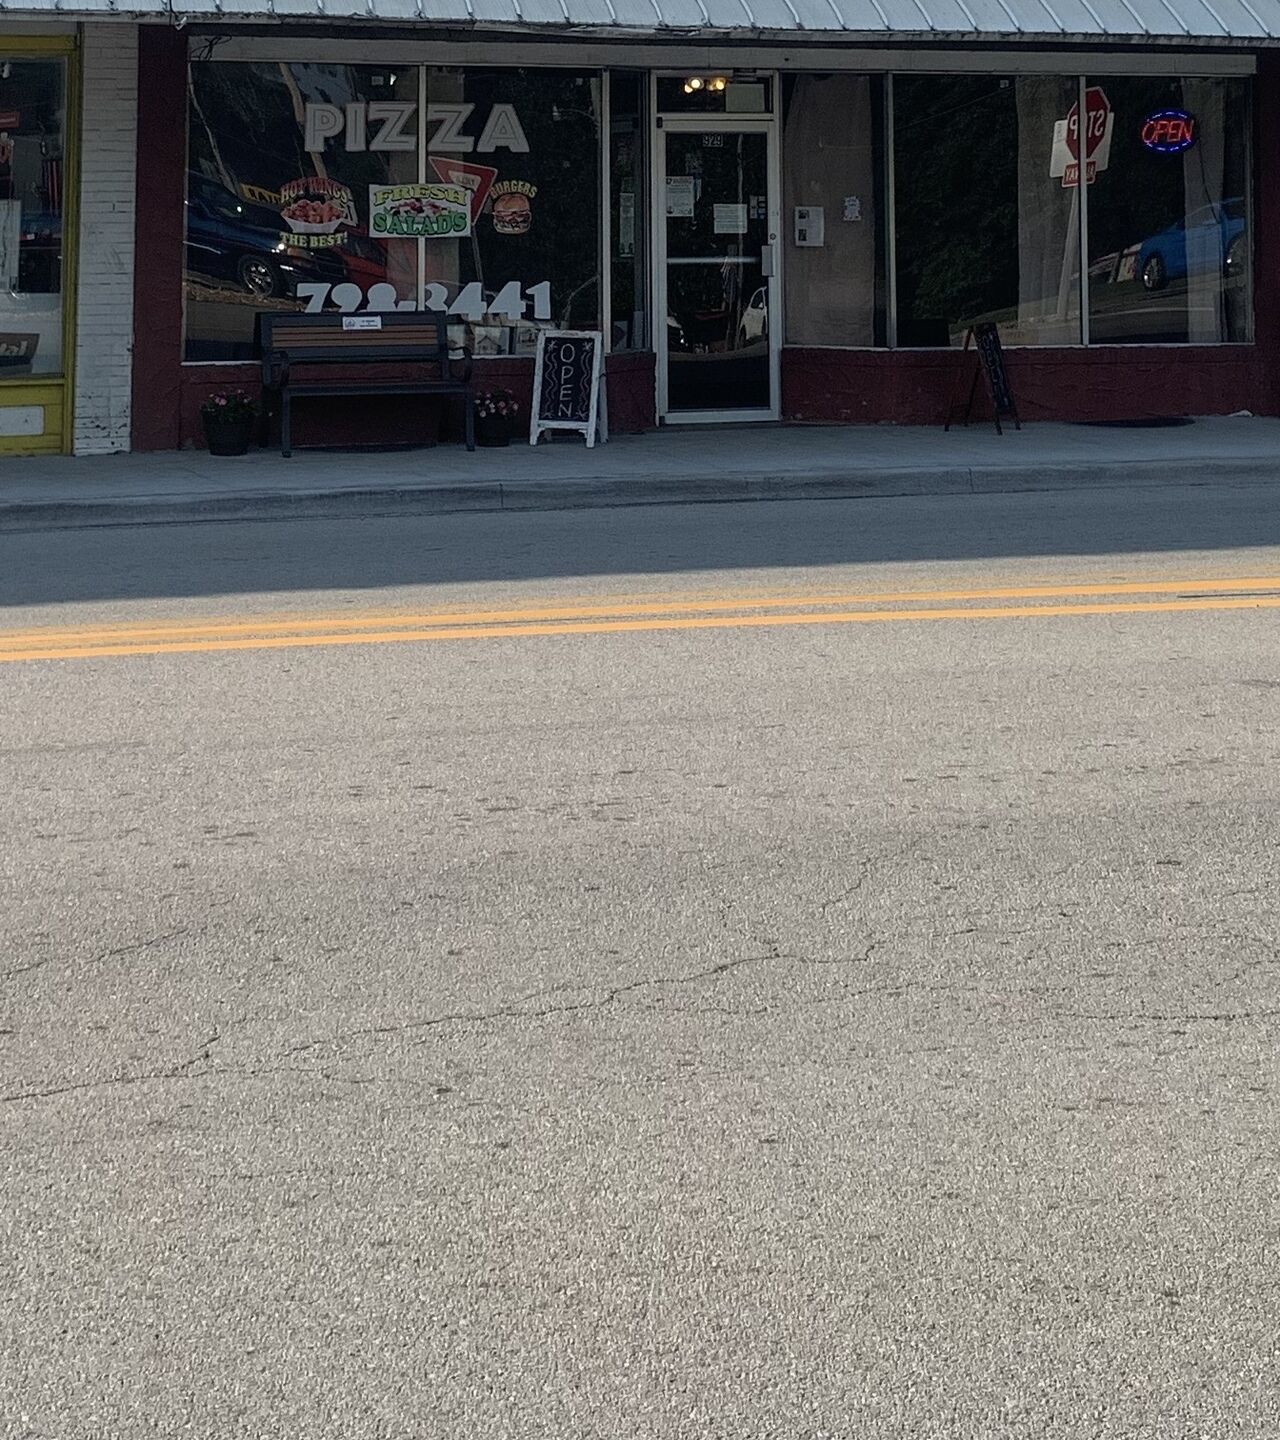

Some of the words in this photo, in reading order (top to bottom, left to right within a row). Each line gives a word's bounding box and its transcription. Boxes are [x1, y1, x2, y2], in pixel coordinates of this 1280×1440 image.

[304, 102, 530, 153] PIZZA
[1141, 119, 1195, 143] OPEN
[281, 178, 308, 203] HOT
[308, 177, 348, 202] WINGS
[374, 184, 467, 207] FRESH
[490, 179, 539, 200] BURGERS
[373, 209, 468, 237] SALADS
[280, 231, 307, 247] THE
[309, 230, 348, 249] BEST!
[557, 343, 576, 418] OPEN
